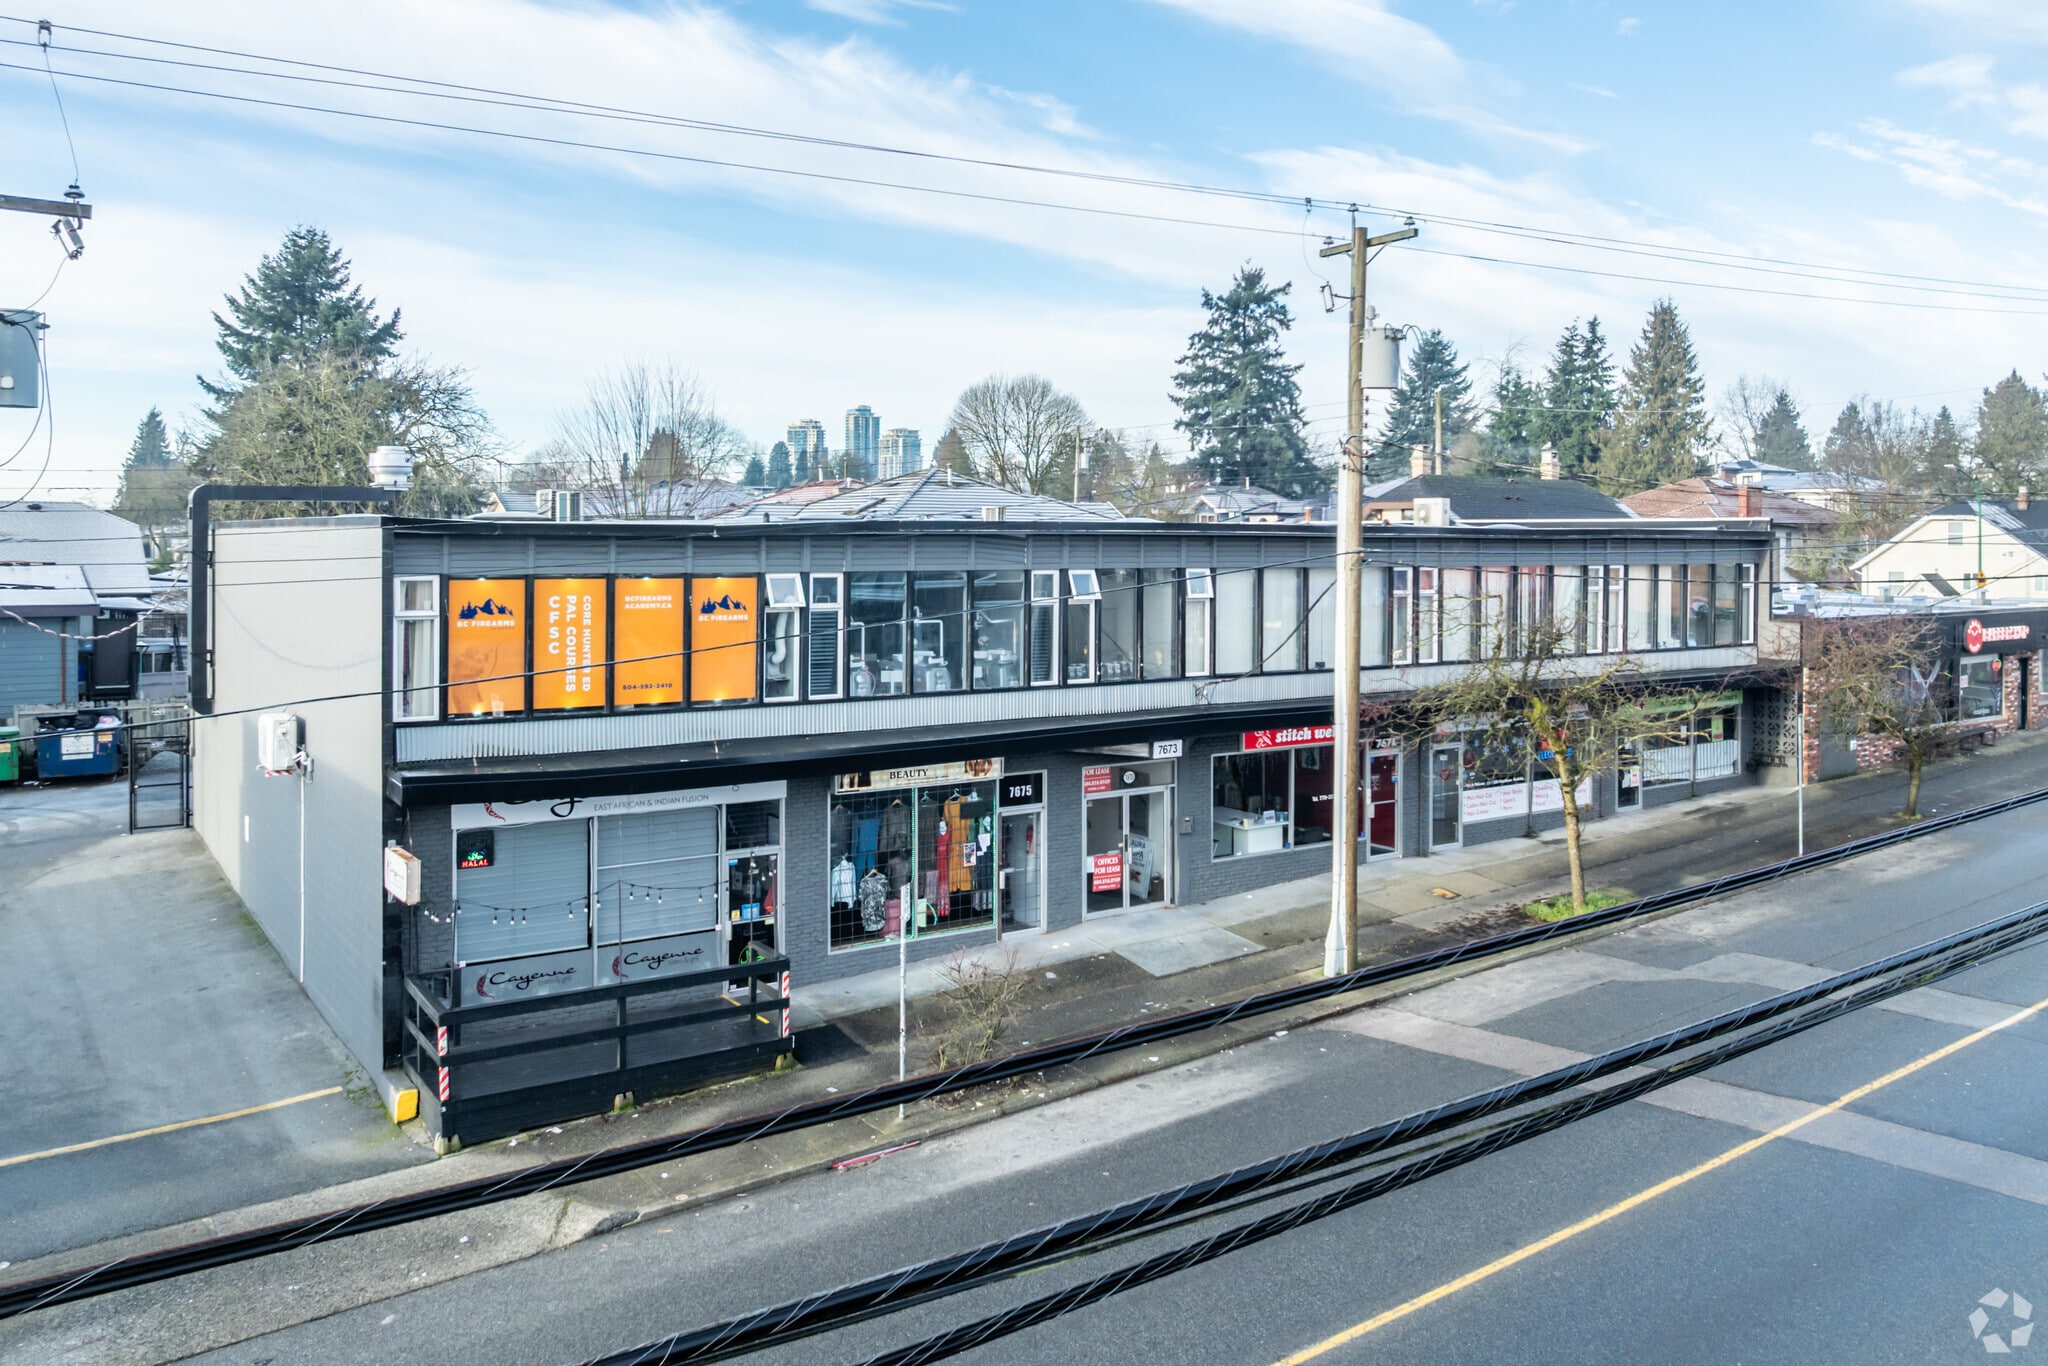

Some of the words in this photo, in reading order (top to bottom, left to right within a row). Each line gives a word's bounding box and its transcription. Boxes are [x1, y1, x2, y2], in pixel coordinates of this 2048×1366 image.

[566, 595, 577, 622] PAL
[583, 595, 592, 626] CORE
[471, 619, 516, 627] FIREARMS
[565, 626, 577, 692] COURSES
[582, 628, 591, 674] HUNTER
[582, 676, 591, 692] ED
[1275, 727, 1312, 743] stitch
[1157, 743, 1178, 755] 7673
[889, 769, 928, 779] BEAUTY
[1084, 768, 1095, 776] FOR
[1096, 767, 1110, 775] LEASE
[1009, 785, 1032, 798] 7675
[593, 802, 612, 811] EAST
[613, 799, 646, 809] AFRICAN
[654, 796, 681, 805] INDIAN
[681, 794, 709, 802] FUSION
[461, 859, 489, 868] HALAL
[1097, 857, 1119, 866] OFFICES
[1094, 867, 1106, 875] FOR
[1106, 865, 1121, 873] LEASE
[624, 948, 704, 970] Cayenne
[489, 967, 577, 990] Cayenne
